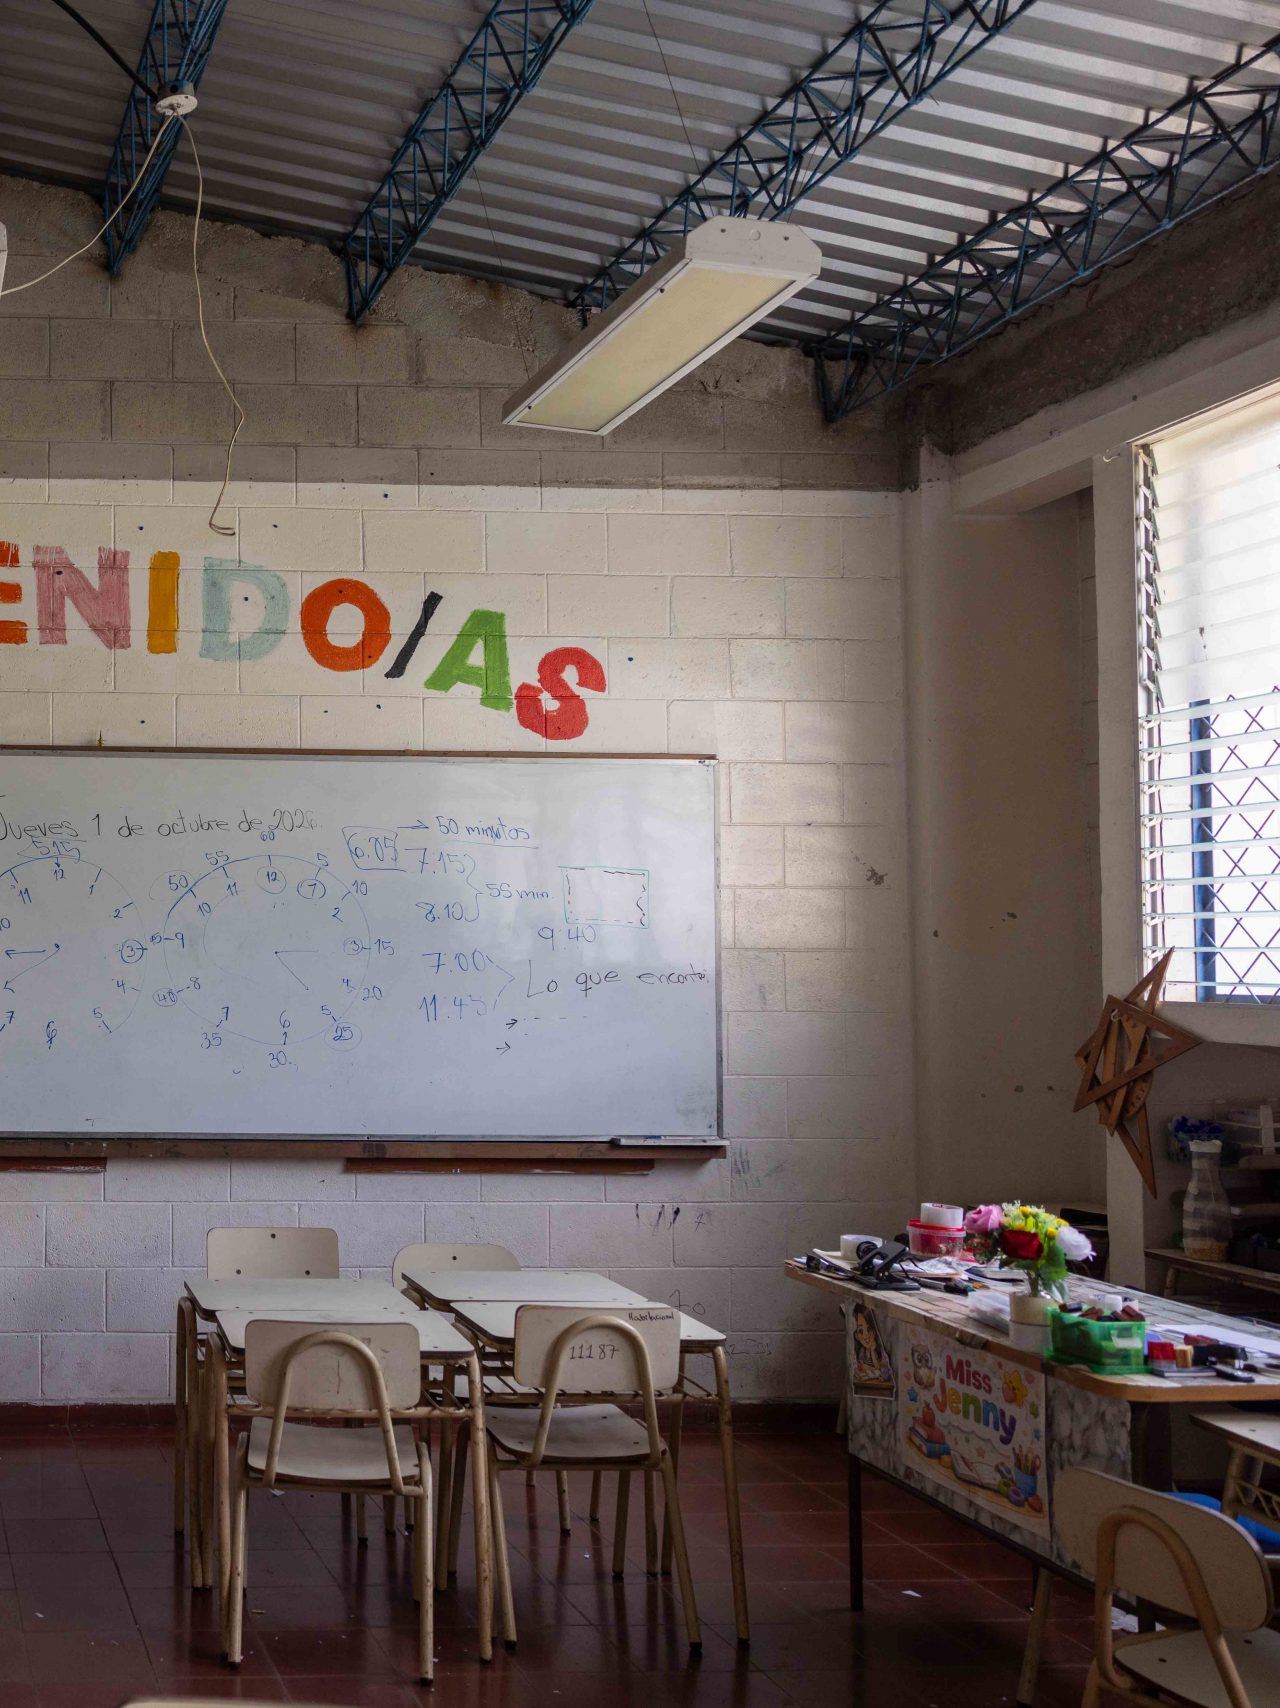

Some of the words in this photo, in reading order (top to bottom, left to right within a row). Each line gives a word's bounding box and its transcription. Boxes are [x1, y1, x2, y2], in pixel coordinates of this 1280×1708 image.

[91, 813, 102, 836] 1
[117, 815, 145, 838] de
[157, 809, 230, 836] octubre
[238, 809, 263, 833] de
[435, 816, 460, 836] 50
[205, 850, 230, 866] 55
[316, 852, 329, 867] 5
[52, 868, 65, 881] 12
[168, 873, 190, 891] 50
[266, 870, 279, 884] 12
[18, 887, 32, 904] 11
[227, 882, 239, 897] 11
[352, 880, 368, 896] 10
[113, 908, 123, 919] 2
[196, 902, 212, 917] 10
[332, 907, 343, 923] 2
[174, 932, 185, 950] 9
[350, 939, 360, 952] 3
[373, 938, 395, 956] 15
[126, 945, 137, 958] 3
[189, 976, 201, 990] 8
[526, 959, 559, 998] Lo
[575, 970, 622, 998] que
[362, 985, 384, 1002] 20
[5, 1010, 16, 1024] 7
[93, 1006, 103, 1019] 5
[320, 1004, 332, 1017] 5
[200, 1031, 223, 1050] 35
[332, 1025, 354, 1042] 25
[945, 1354, 993, 1395] Miss
[932, 1377, 1017, 1446] Jenny
